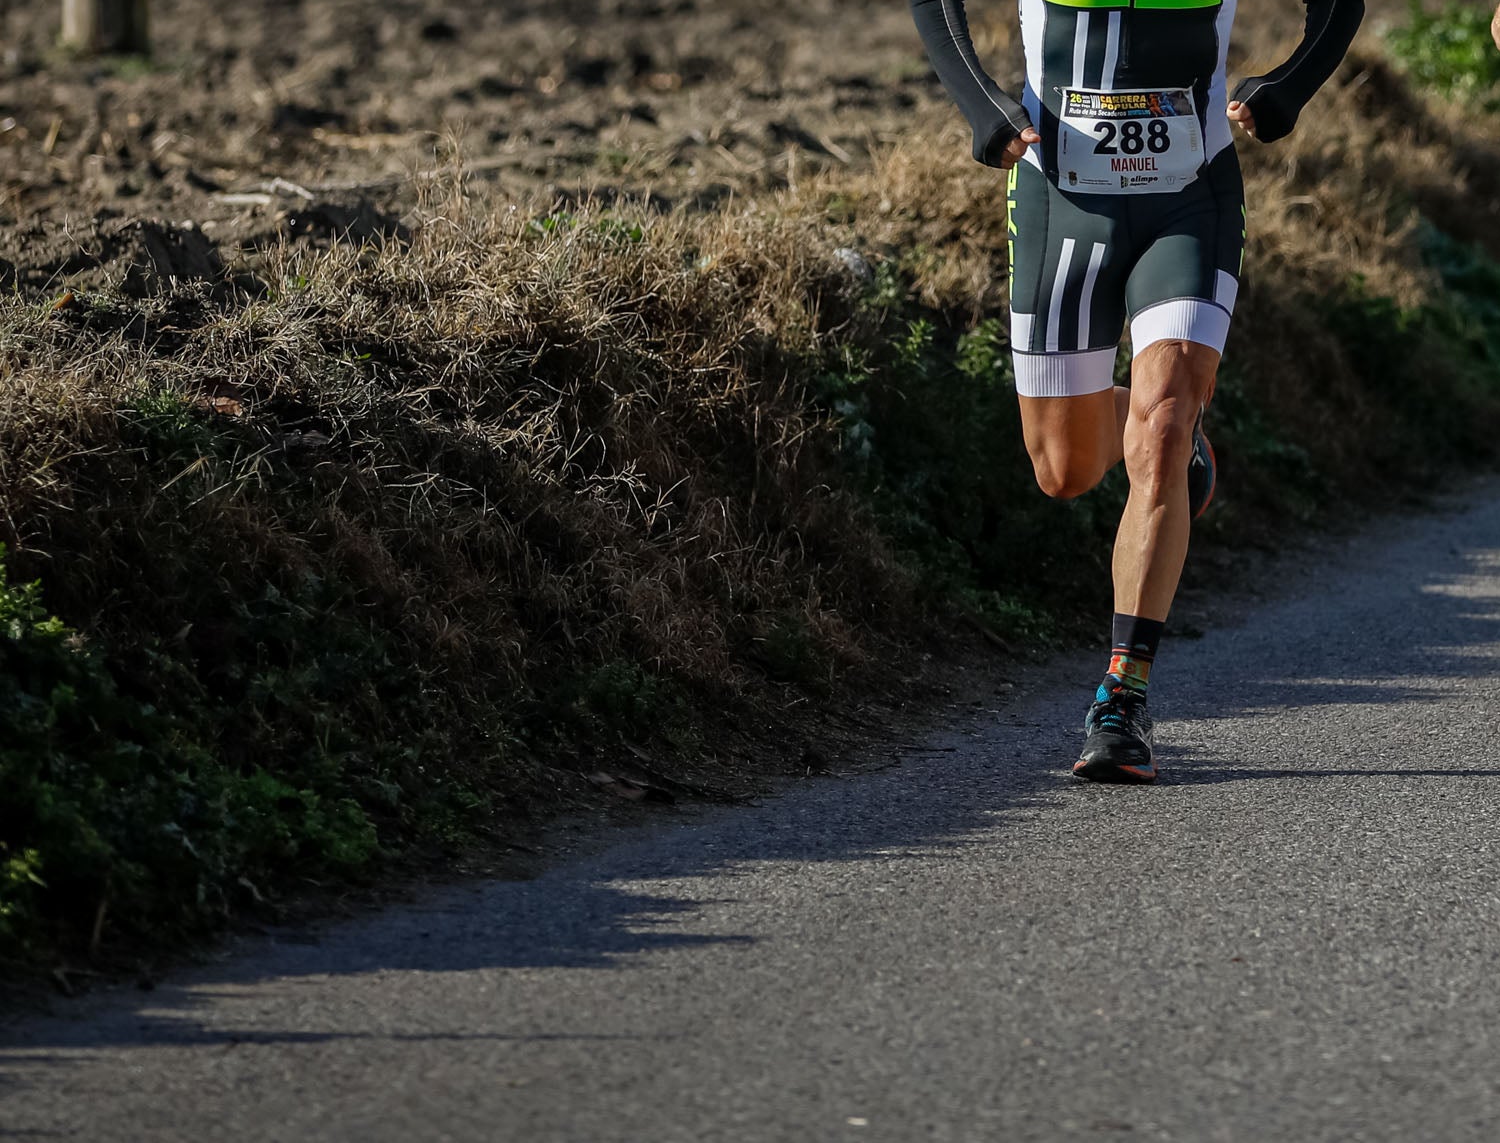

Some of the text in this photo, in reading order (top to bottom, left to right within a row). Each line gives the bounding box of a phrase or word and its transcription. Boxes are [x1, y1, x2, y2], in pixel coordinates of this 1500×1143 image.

[1070, 93, 1082, 103] 26
[1090, 95, 1100, 109] VII
[1100, 95, 1147, 105] CARRERA
[1101, 103, 1147, 111] POPULAR
[1093, 119, 1171, 155] 288
[1111, 157, 1158, 172] MANUEL
[1130, 176, 1158, 184] olimpo
